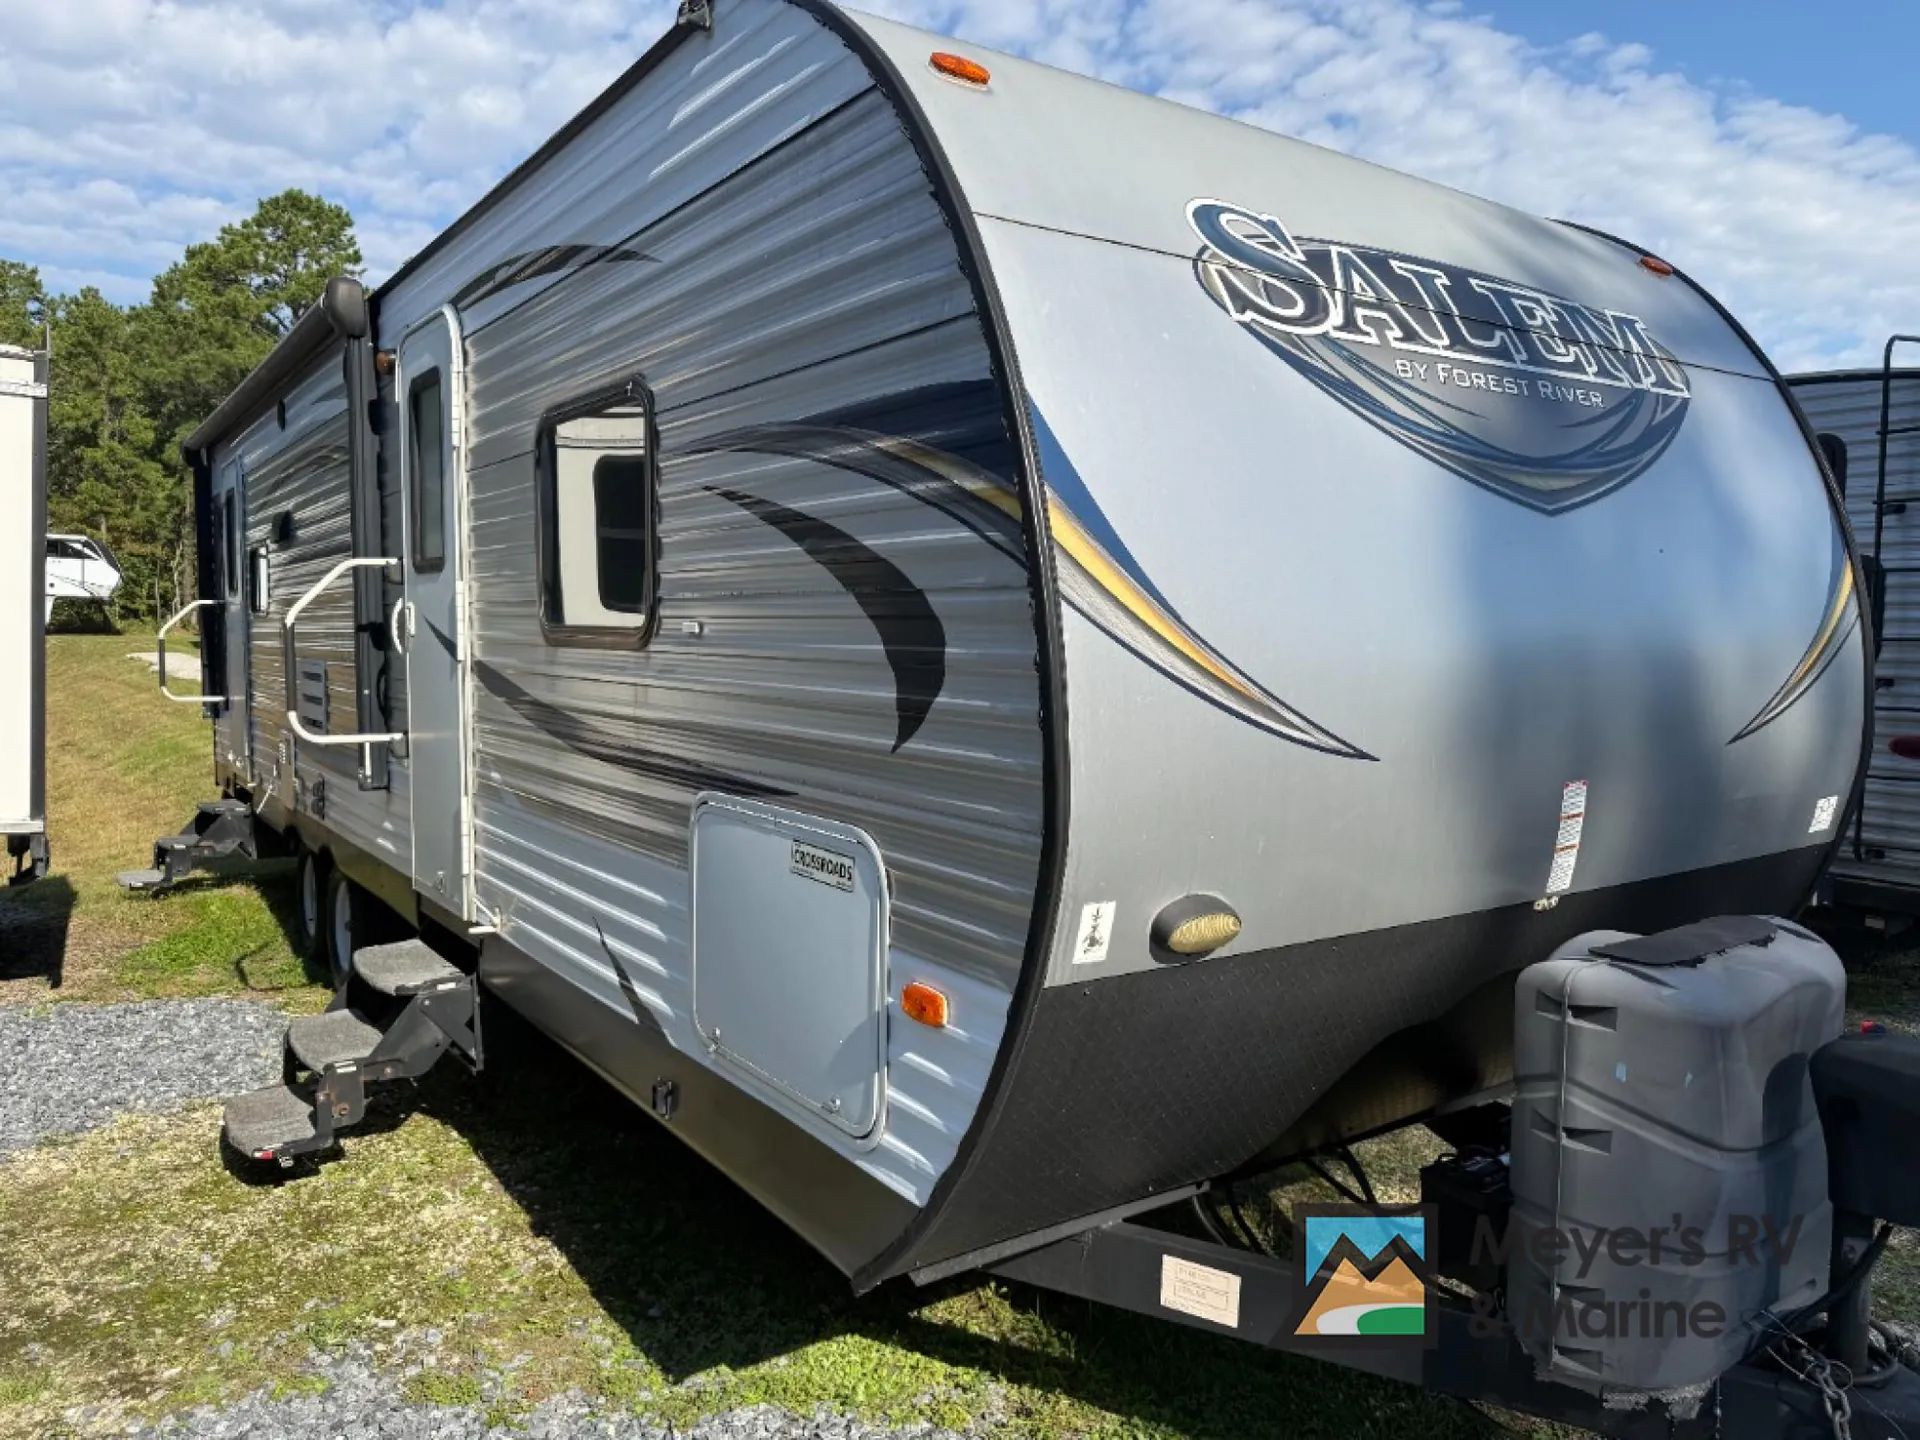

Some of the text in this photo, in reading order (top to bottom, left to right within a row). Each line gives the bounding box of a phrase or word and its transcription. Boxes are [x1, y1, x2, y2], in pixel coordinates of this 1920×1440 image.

[1186, 197, 1691, 399] SALEM
[1396, 358, 1605, 409] BY FOREST RIVER
[794, 849, 853, 882] CROSSROADS
